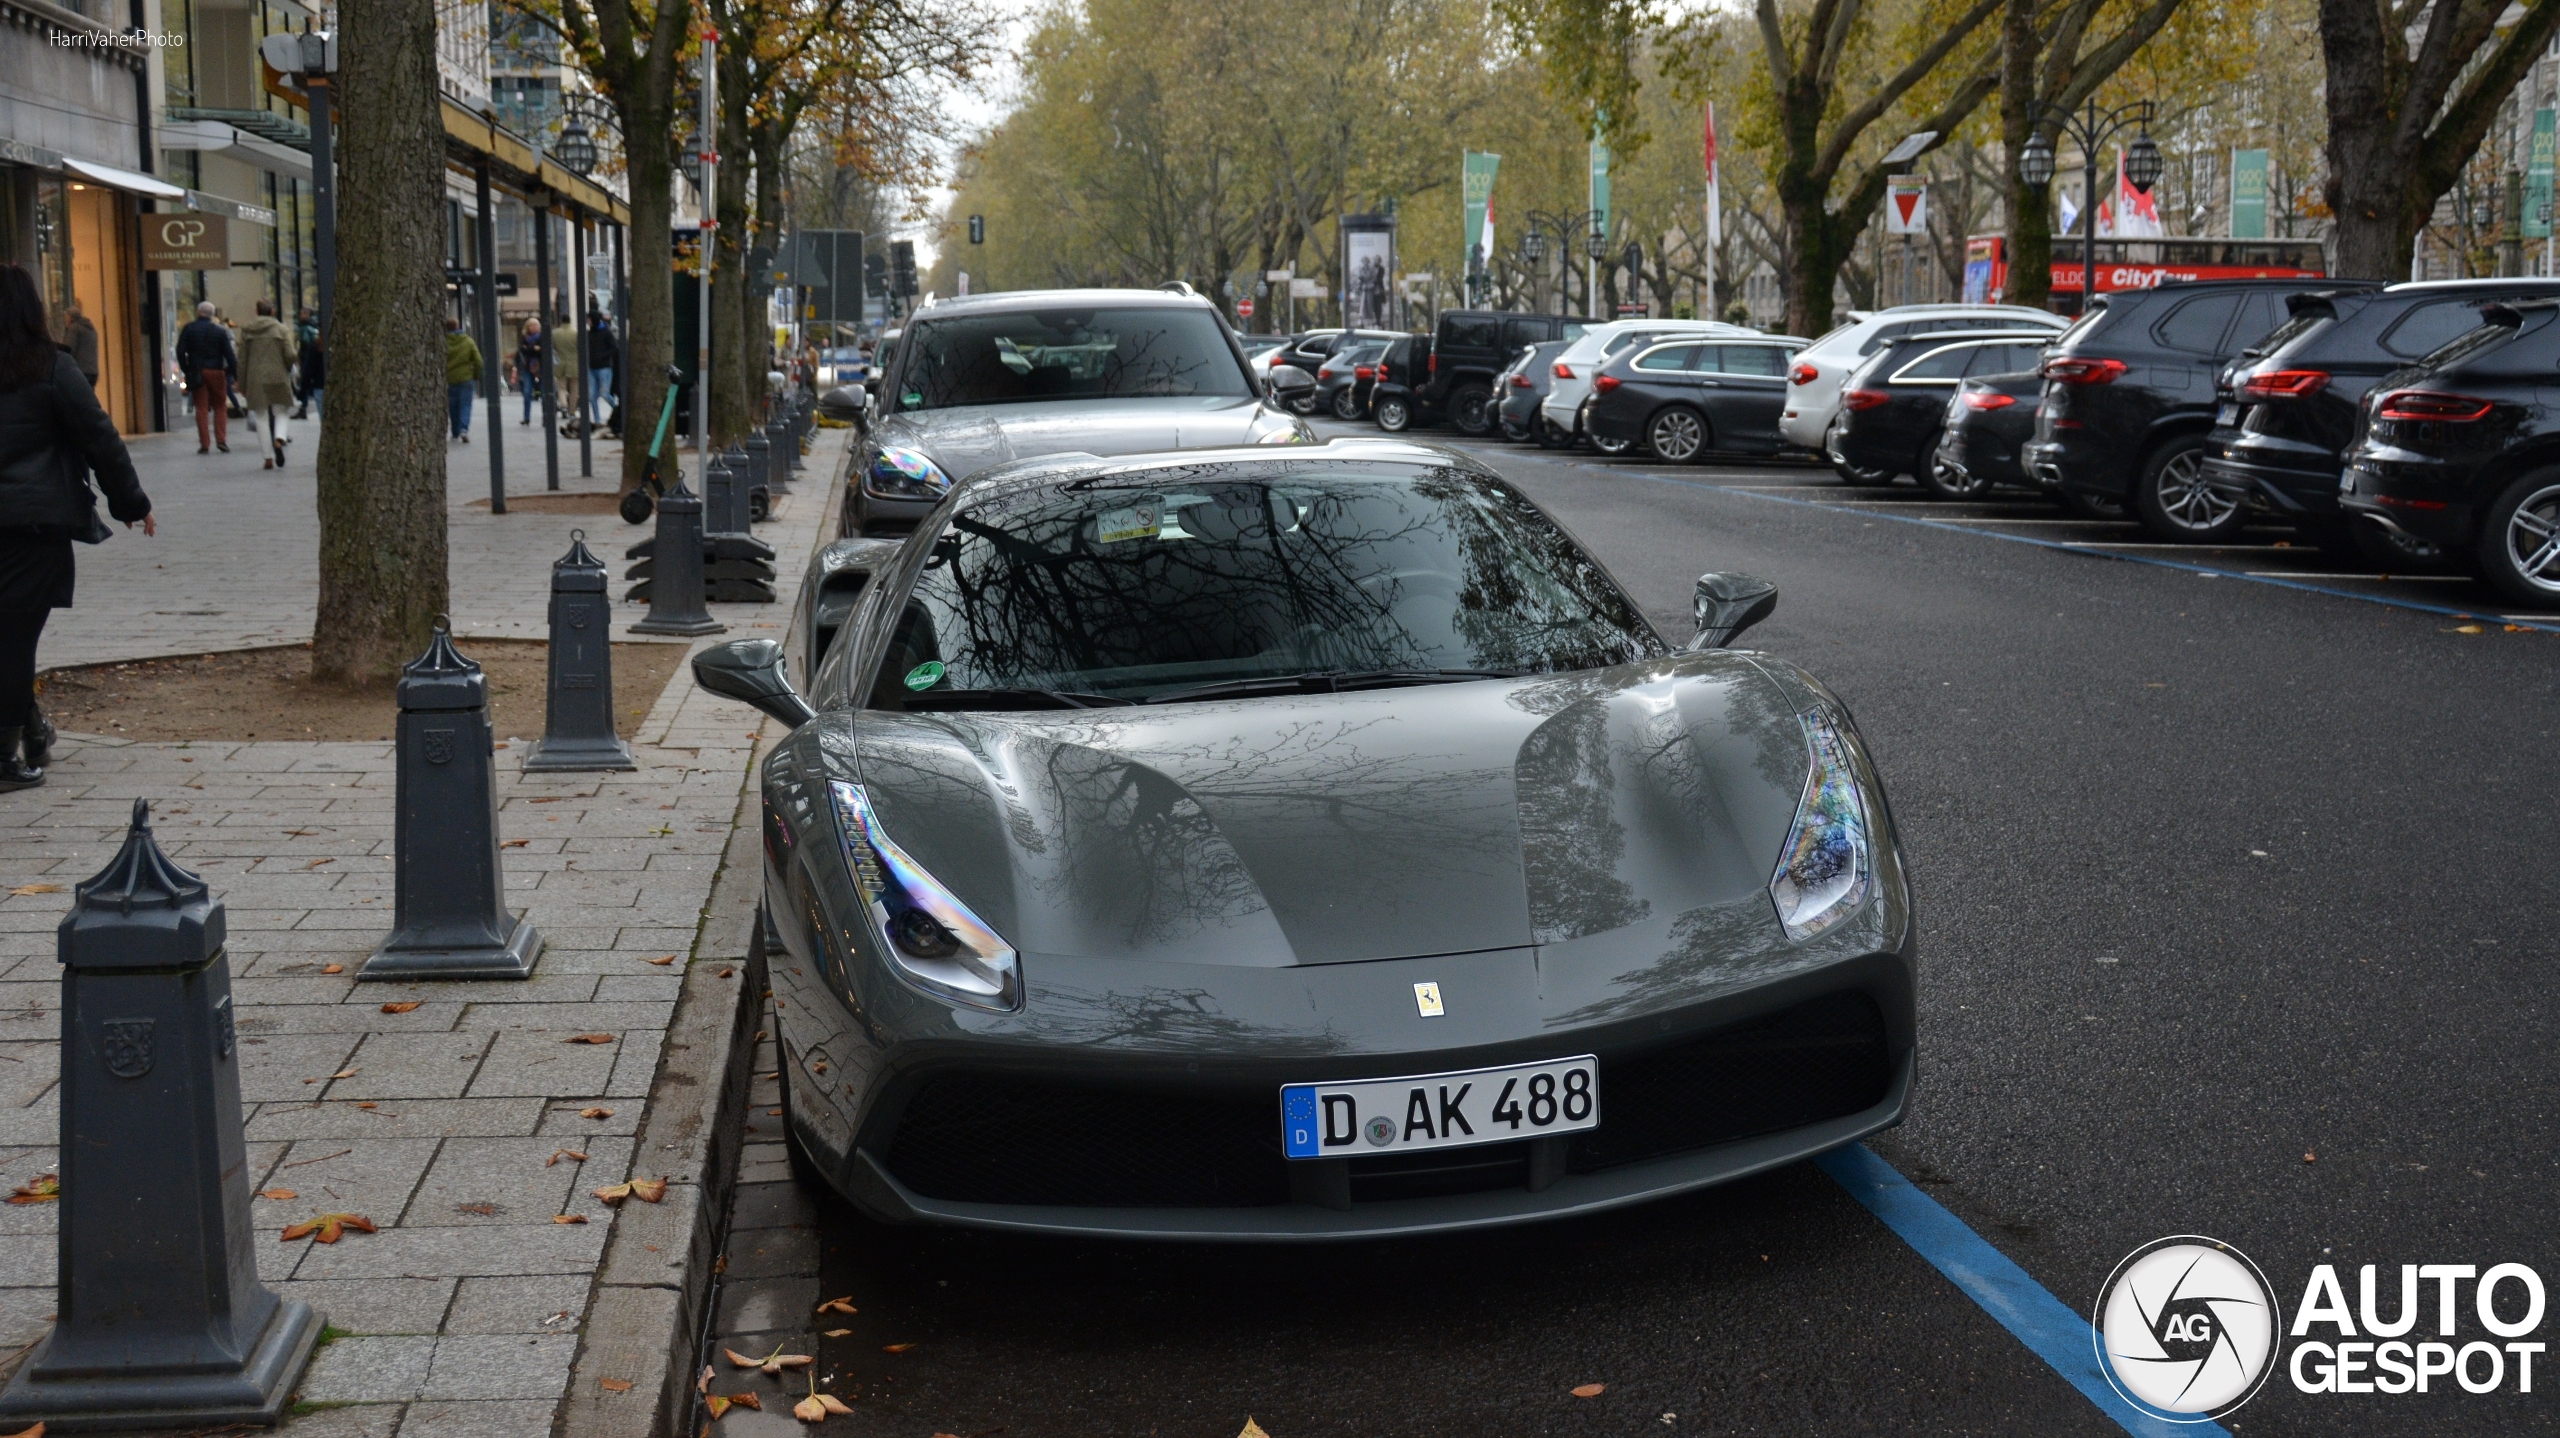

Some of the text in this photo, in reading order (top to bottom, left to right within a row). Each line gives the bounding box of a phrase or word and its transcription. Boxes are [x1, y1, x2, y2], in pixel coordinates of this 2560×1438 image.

[162, 220, 205, 247] GP
[920, 663, 933, 676] 4
[1321, 1093, 1358, 1147] D
[1403, 1082, 1475, 1142] AK
[1491, 1067, 1593, 1130] 488
[1295, 1129, 1308, 1145] D
